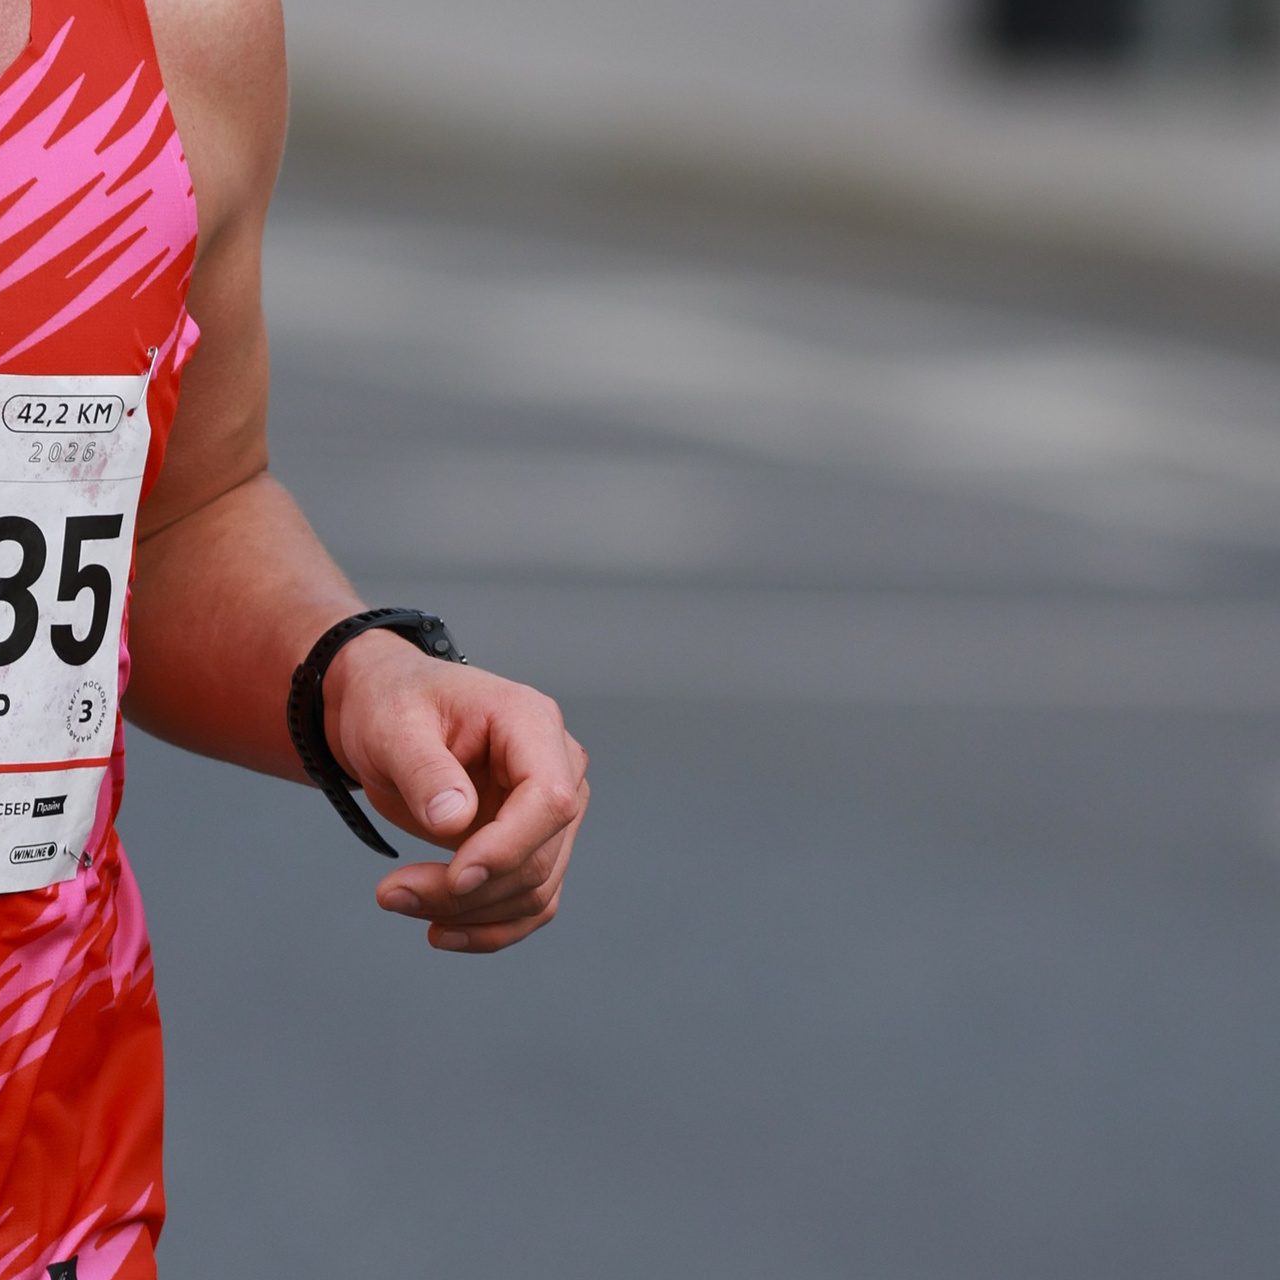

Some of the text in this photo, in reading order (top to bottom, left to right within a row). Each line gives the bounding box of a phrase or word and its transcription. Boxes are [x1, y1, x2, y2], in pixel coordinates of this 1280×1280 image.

[16, 402, 68, 427] 42,2
[27, 441, 97, 463] 2026
[78, 699, 93, 723] 3
[36, 800, 61, 814] Прайм
[13, 847, 47, 861] WINLINE
